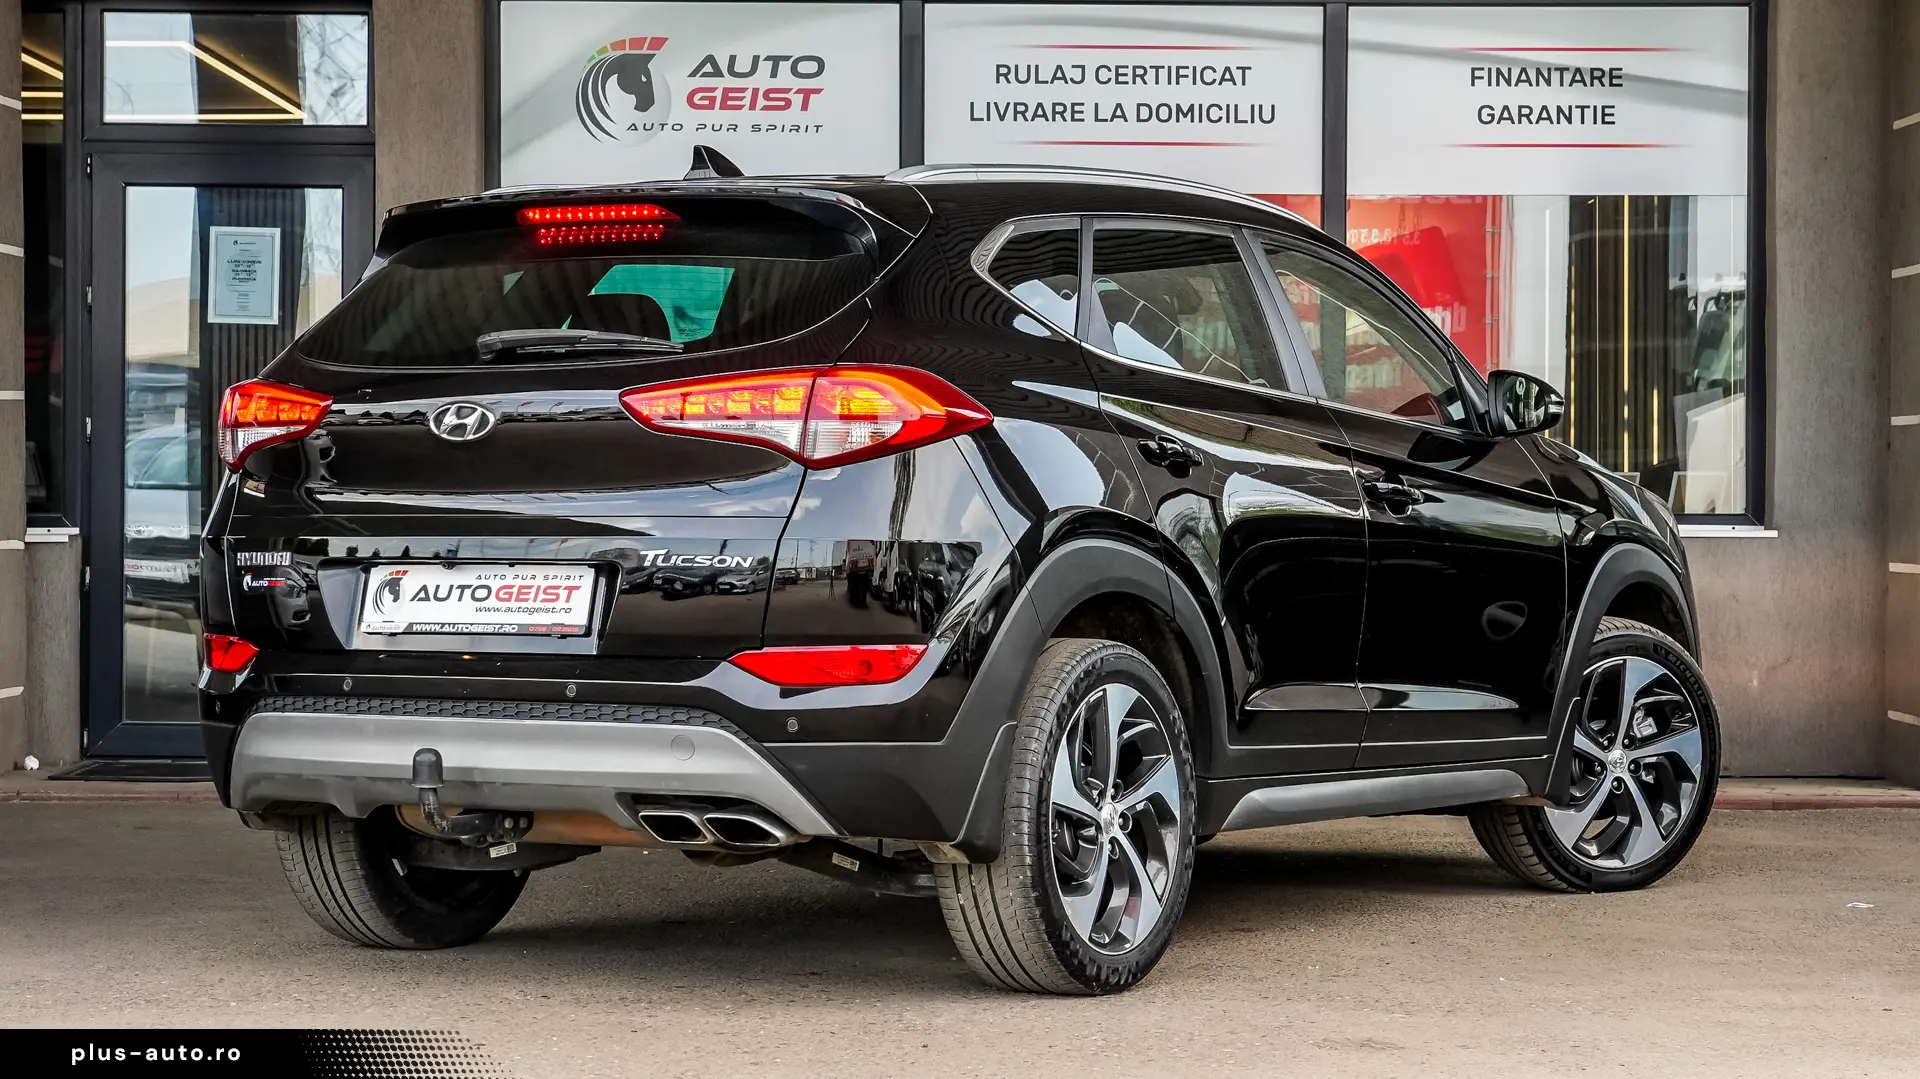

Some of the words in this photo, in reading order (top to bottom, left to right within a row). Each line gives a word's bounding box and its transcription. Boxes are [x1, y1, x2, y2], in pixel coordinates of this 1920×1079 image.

[687, 54, 826, 80] AUTO
[995, 63, 1087, 85] RULAJ
[1094, 64, 1252, 86] CERTIFICAT
[1470, 66, 1624, 88] FINANTARE
[686, 86, 825, 112] GEIST
[969, 101, 1086, 122] LIVRARE
[1094, 102, 1129, 123] LA
[1135, 102, 1277, 124] DOMICILIU
[1477, 104, 1616, 125] GARANTIE
[626, 122, 684, 132] AUTO
[696, 123, 739, 133] PUR
[751, 123, 825, 134] SPIRIT
[237, 551, 292, 566] HYUNDAI
[640, 548, 754, 568] TUCSON
[409, 584, 582, 603] AUTOGEIST
[475, 605, 573, 615] www.autogeist.ro
[412, 623, 519, 633] WWW.AUTOGEIST.RO
[1667, 653, 1706, 704] MICHELIN
